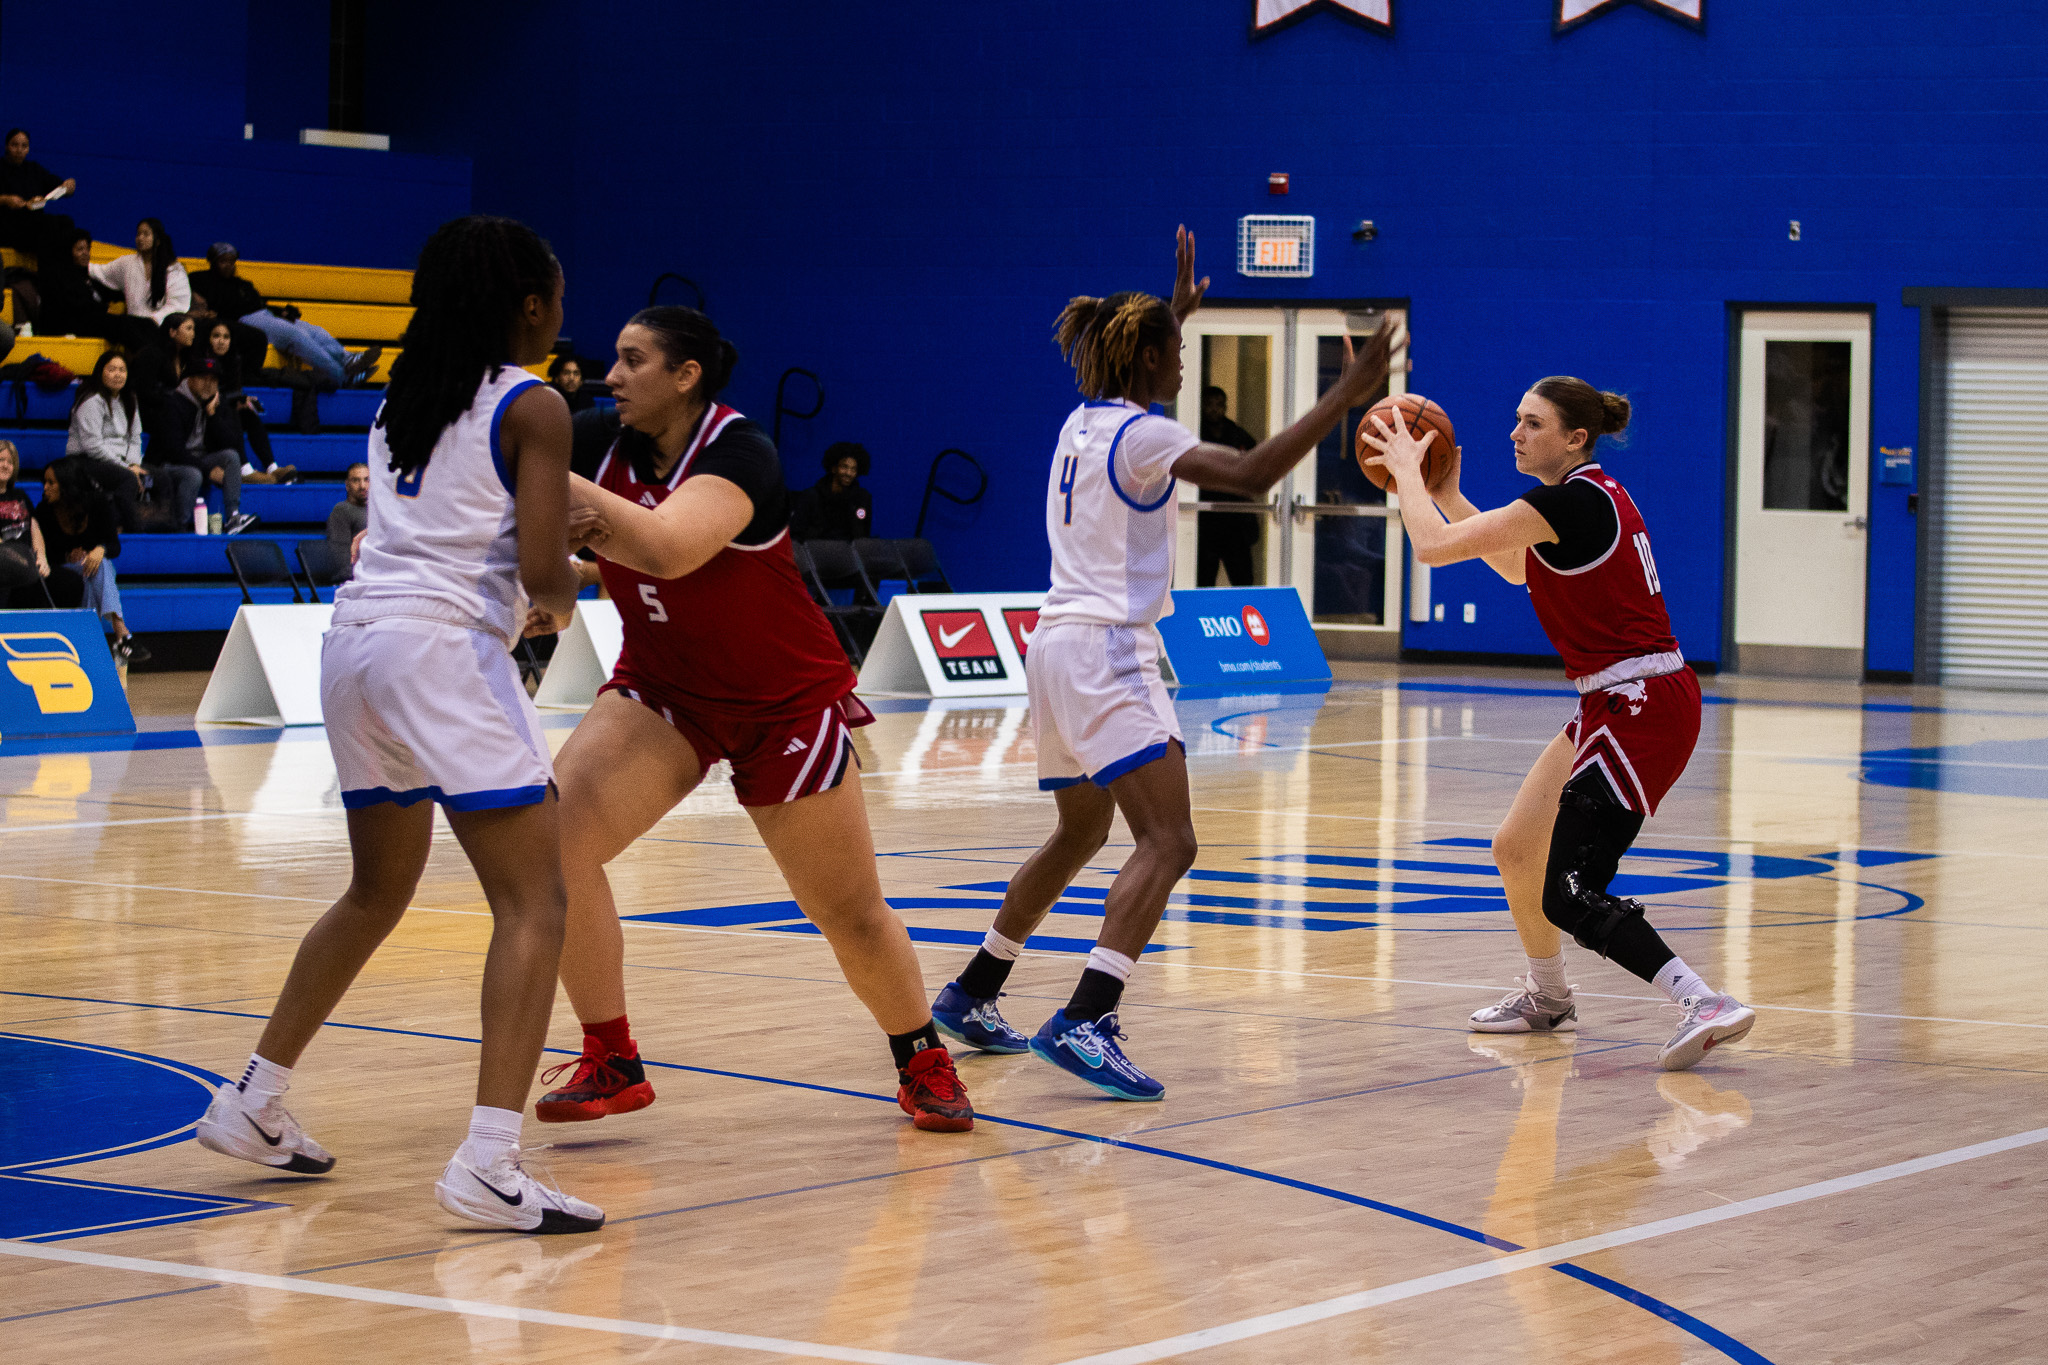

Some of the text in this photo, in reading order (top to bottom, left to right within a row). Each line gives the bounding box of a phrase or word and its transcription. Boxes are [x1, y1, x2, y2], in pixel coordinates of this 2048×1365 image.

[1260, 240, 1295, 265] EXIT
[1059, 453, 1079, 527] 4
[637, 582, 669, 623] 5
[1198, 615, 1242, 638] BMO
[946, 659, 998, 676] TEAM
